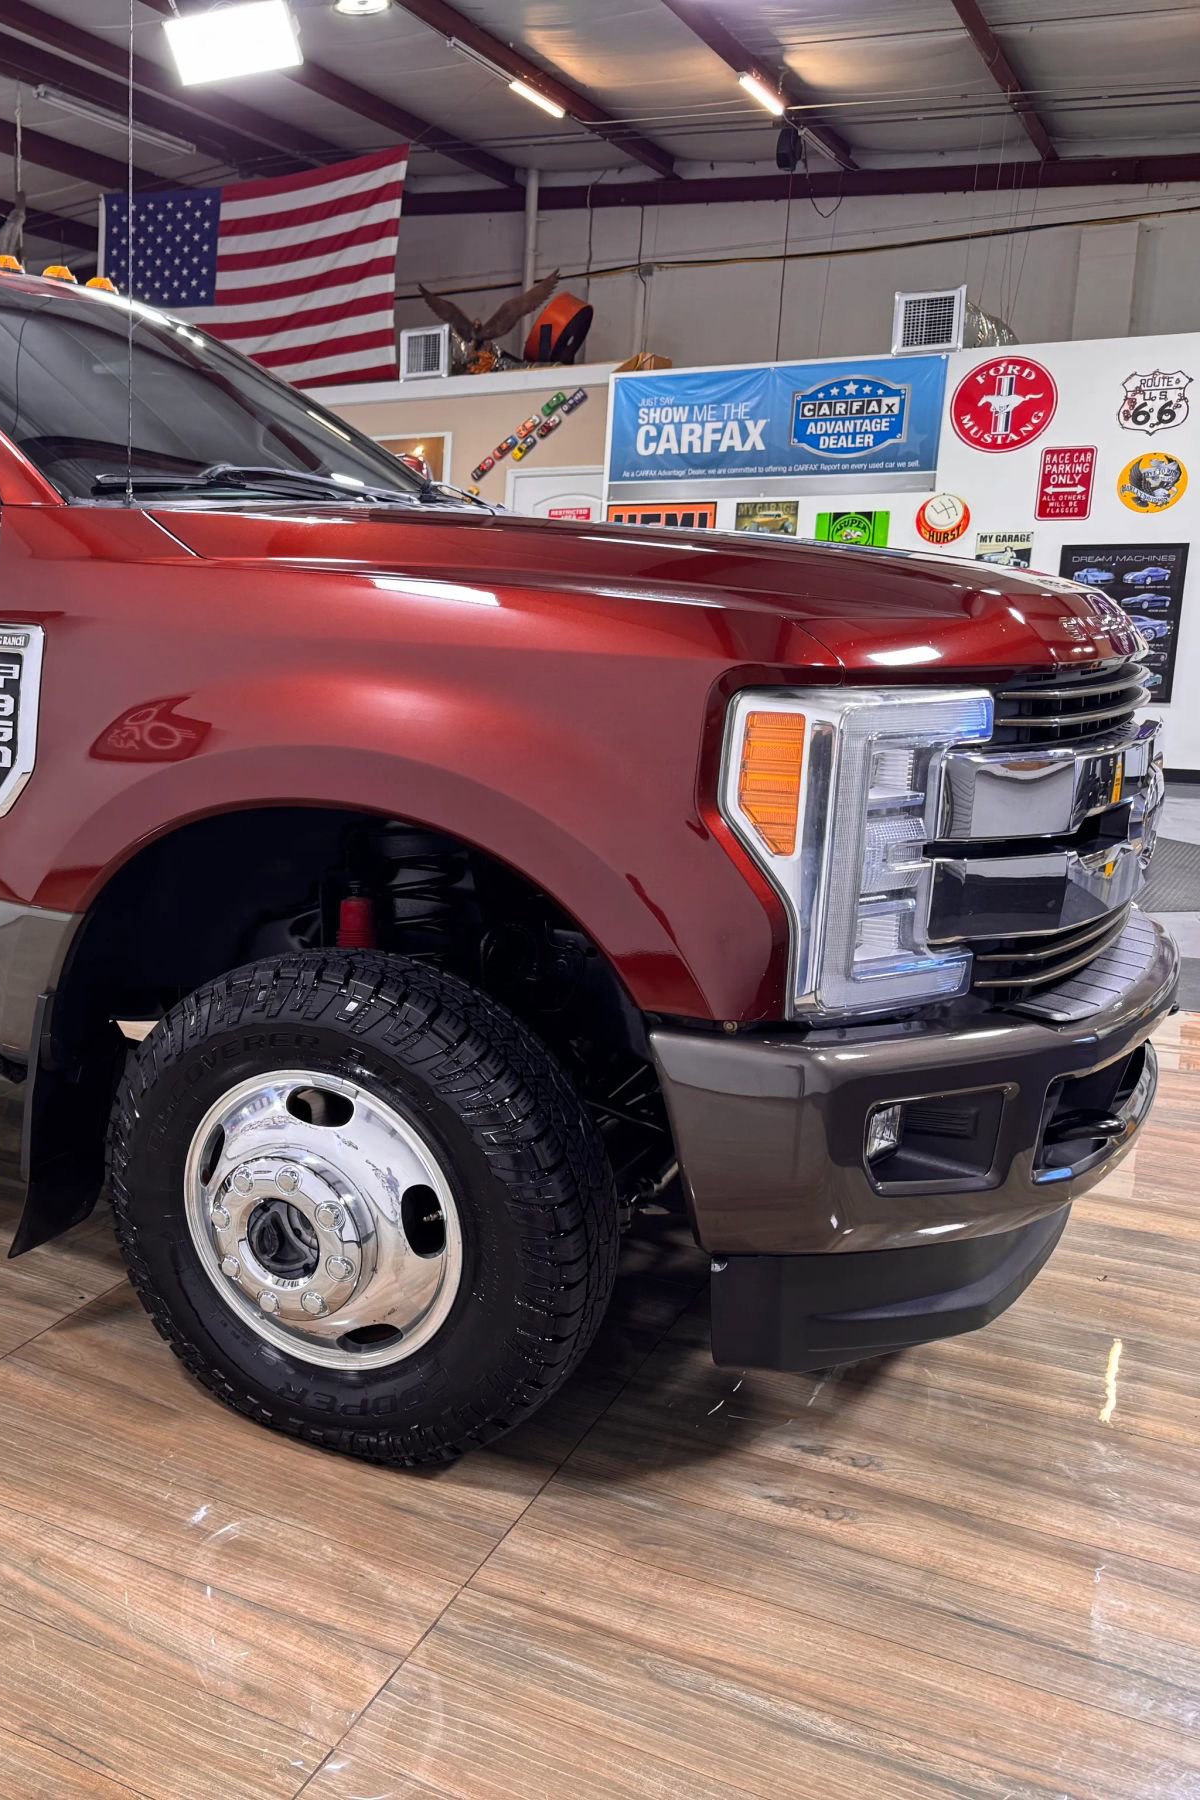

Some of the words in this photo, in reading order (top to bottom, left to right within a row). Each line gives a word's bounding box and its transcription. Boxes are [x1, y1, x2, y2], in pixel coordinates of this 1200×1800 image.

[975, 363, 1036, 385] FORD
[1140, 376, 1174, 388] ROUTE
[638, 398, 658, 407] JUST
[660, 396, 675, 405] SAY
[803, 401, 896, 416] CARFAX
[638, 405, 689, 424] SHOW
[693, 403, 717, 422] ME
[722, 401, 751, 420] THE
[806, 418, 890, 435] ADVANTAGE
[960, 410, 1044, 444] MUSTANG
[636, 419, 767, 456] CARFAX
[819, 434, 874, 449] DEALER
[1045, 452, 1070, 464] RACE
[1073, 452, 1092, 463] CAR
[622, 470, 630, 478] As
[765, 465, 787, 474] offering
[793, 464, 817, 472] CARFAX
[820, 463, 840, 472] Report
[1044, 463, 1089, 474] PARKING
[1050, 474, 1082, 484] ONLY
[550, 508, 588, 516] RESTRICTED
[835, 518, 867, 534] SUPER
[928, 523, 962, 544] HURST
[979, 534, 993, 543] MY
[995, 533, 1030, 543] GARAGE
[1072, 555, 1113, 563] DREAM
[3, 636, 25, 646] RANCH
